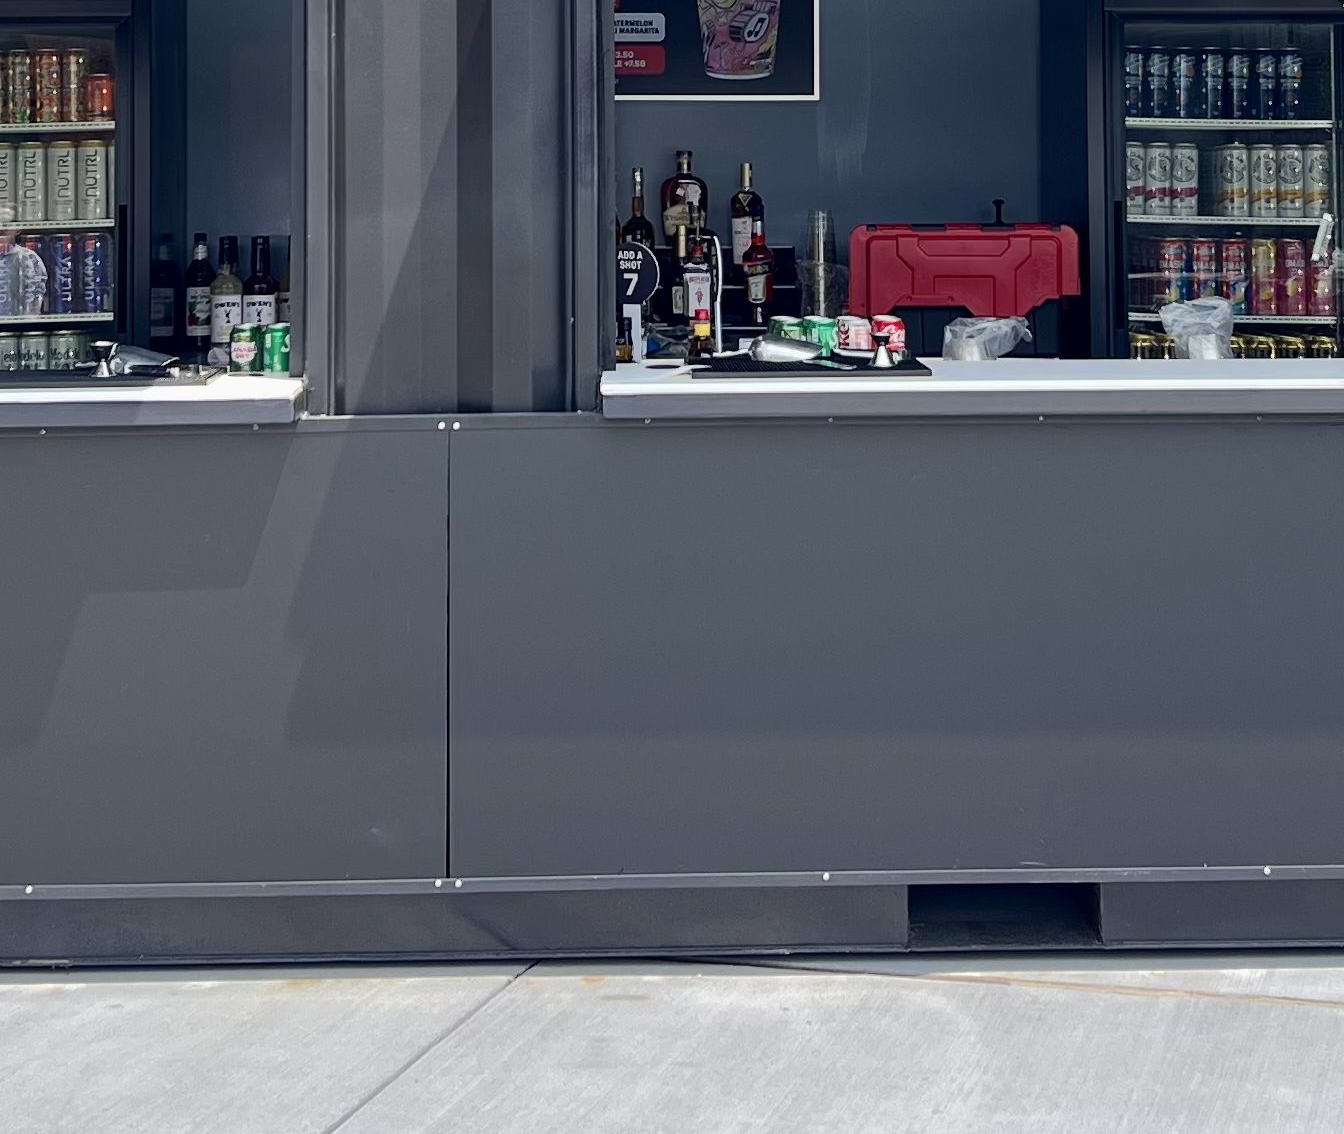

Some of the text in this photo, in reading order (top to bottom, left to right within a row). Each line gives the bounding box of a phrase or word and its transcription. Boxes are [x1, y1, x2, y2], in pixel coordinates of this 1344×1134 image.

[614, 19, 654, 27] TERMELON
[617, 250, 643, 260] ADD A
[619, 261, 642, 270] SHOT
[623, 273, 639, 296] 7
